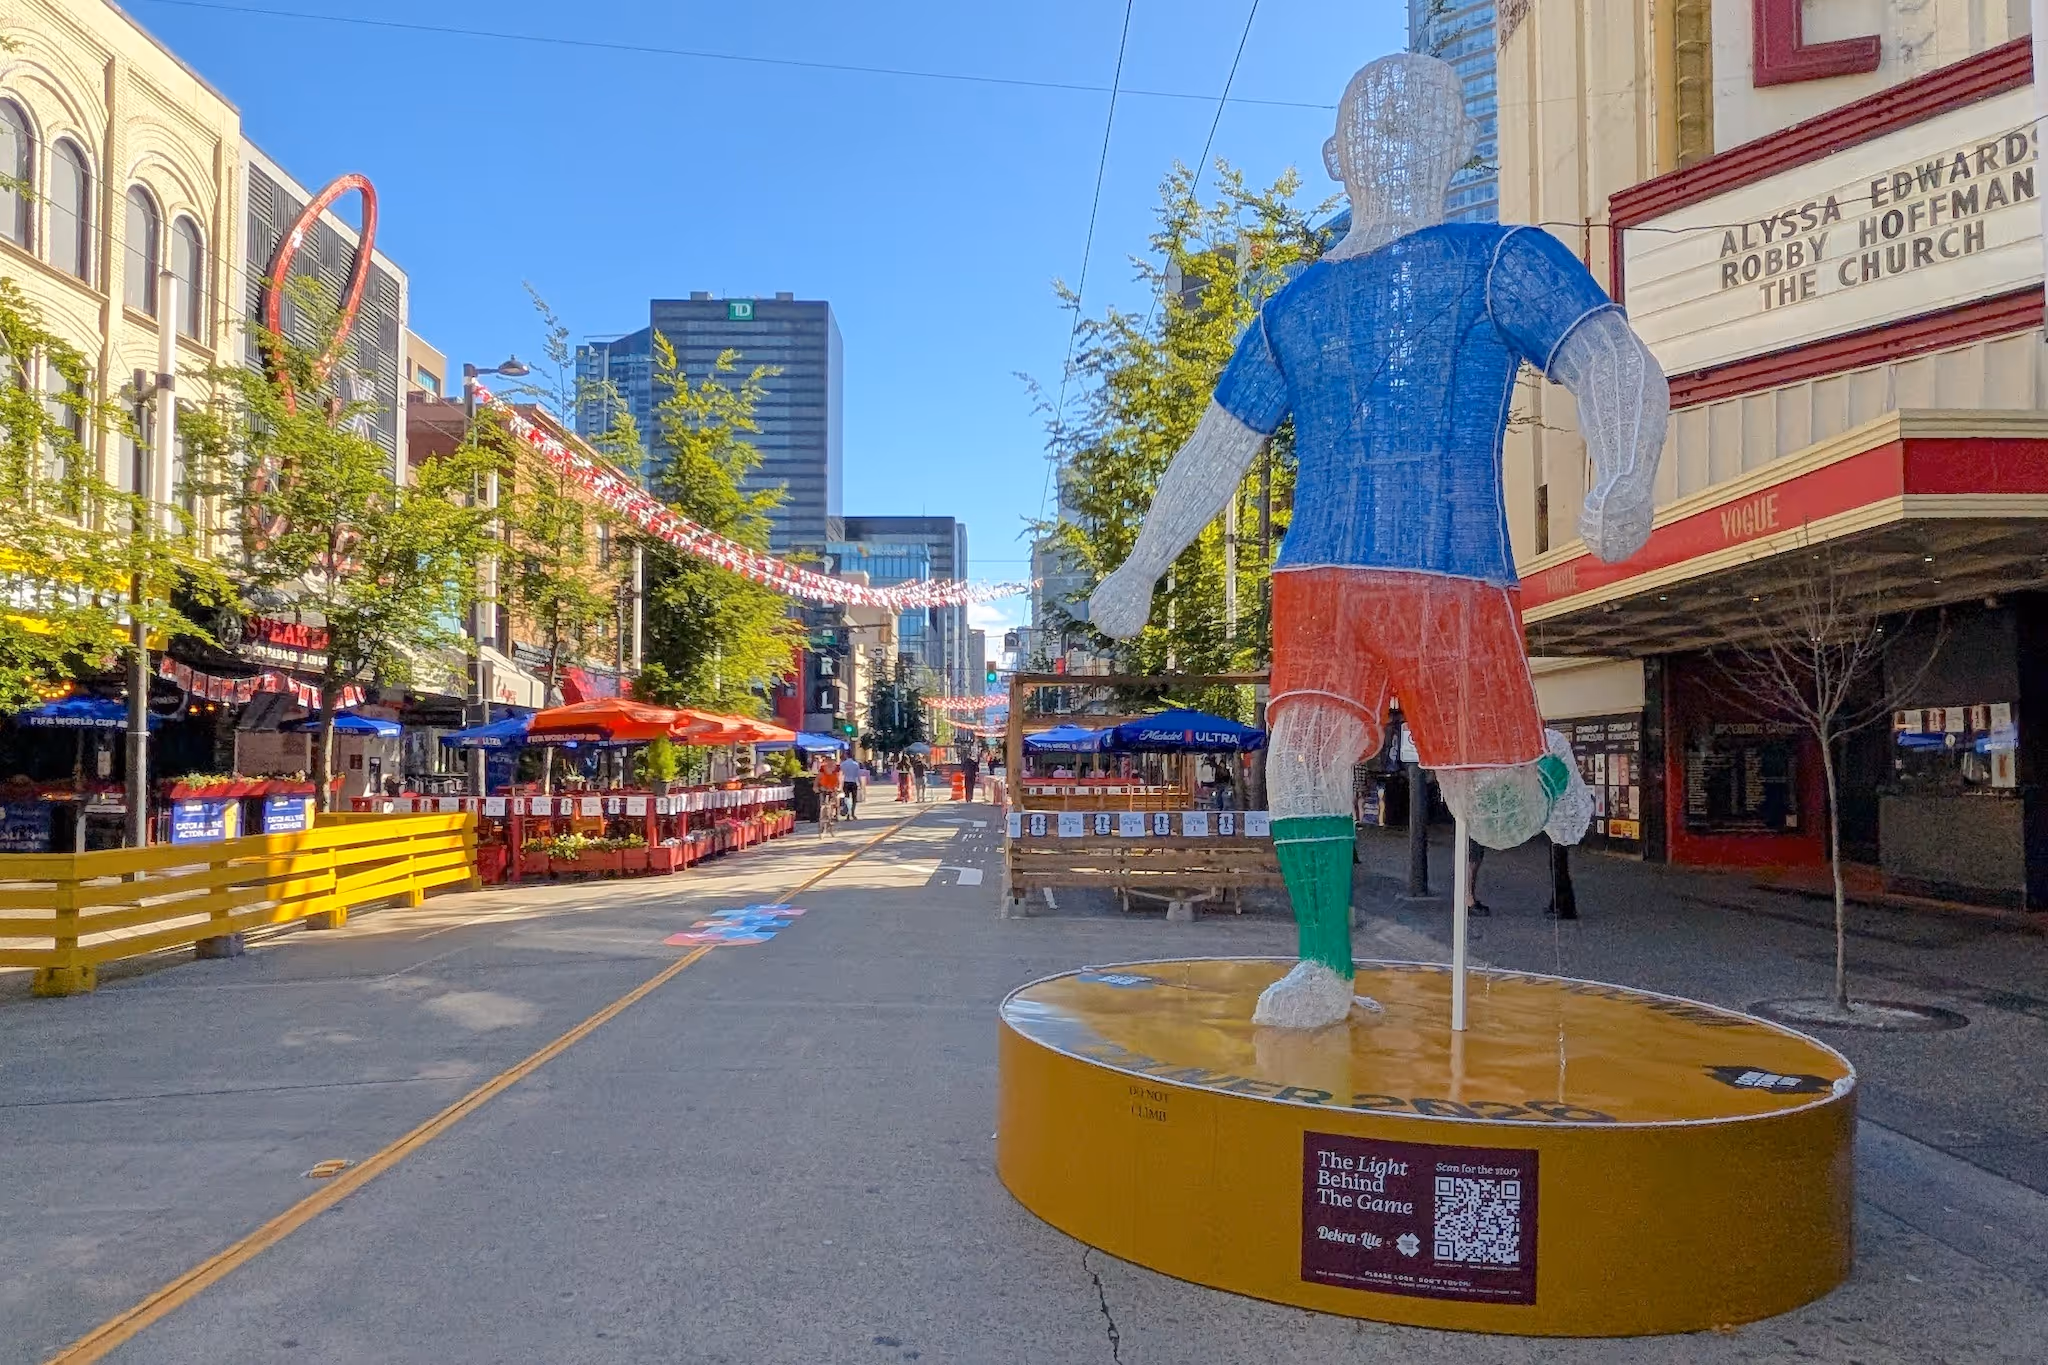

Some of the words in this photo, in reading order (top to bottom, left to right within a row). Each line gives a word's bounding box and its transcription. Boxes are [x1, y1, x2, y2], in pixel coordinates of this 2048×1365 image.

[1719, 195, 1842, 259] ALYSSA
[1721, 232, 1830, 289] ROBBY
[1859, 166, 2035, 249] HOFFMAN
[1760, 269, 1817, 311] THE
[1838, 219, 1986, 287] CHURCH
[730, 303, 751, 317] TD
[1720, 493, 1779, 540] VOGUE
[1546, 560, 1578, 594] VOGUE
[30, 716, 55, 726] FIFA
[55, 717, 95, 727] WORLD
[94, 718, 117, 727] CUP
[1195, 731, 1241, 745] ULTRA
[1129, 1086, 1144, 1099] DO
[1146, 1089, 1168, 1103] NOT
[1131, 1104, 1167, 1122] CLIMB
[1351, 1093, 1617, 1123] 2026
[1318, 1151, 1354, 1170] The
[1357, 1156, 1409, 1178] Light
[1436, 1162, 1460, 1173] Scan
[1461, 1163, 1477, 1174] for
[1477, 1164, 1494, 1175] the
[1494, 1166, 1520, 1178] story
[1318, 1169, 1385, 1193] Behind
[1317, 1188, 1353, 1208] The
[1357, 1194, 1413, 1215] Game
[1365, 1270, 1392, 1279] PLEASE
